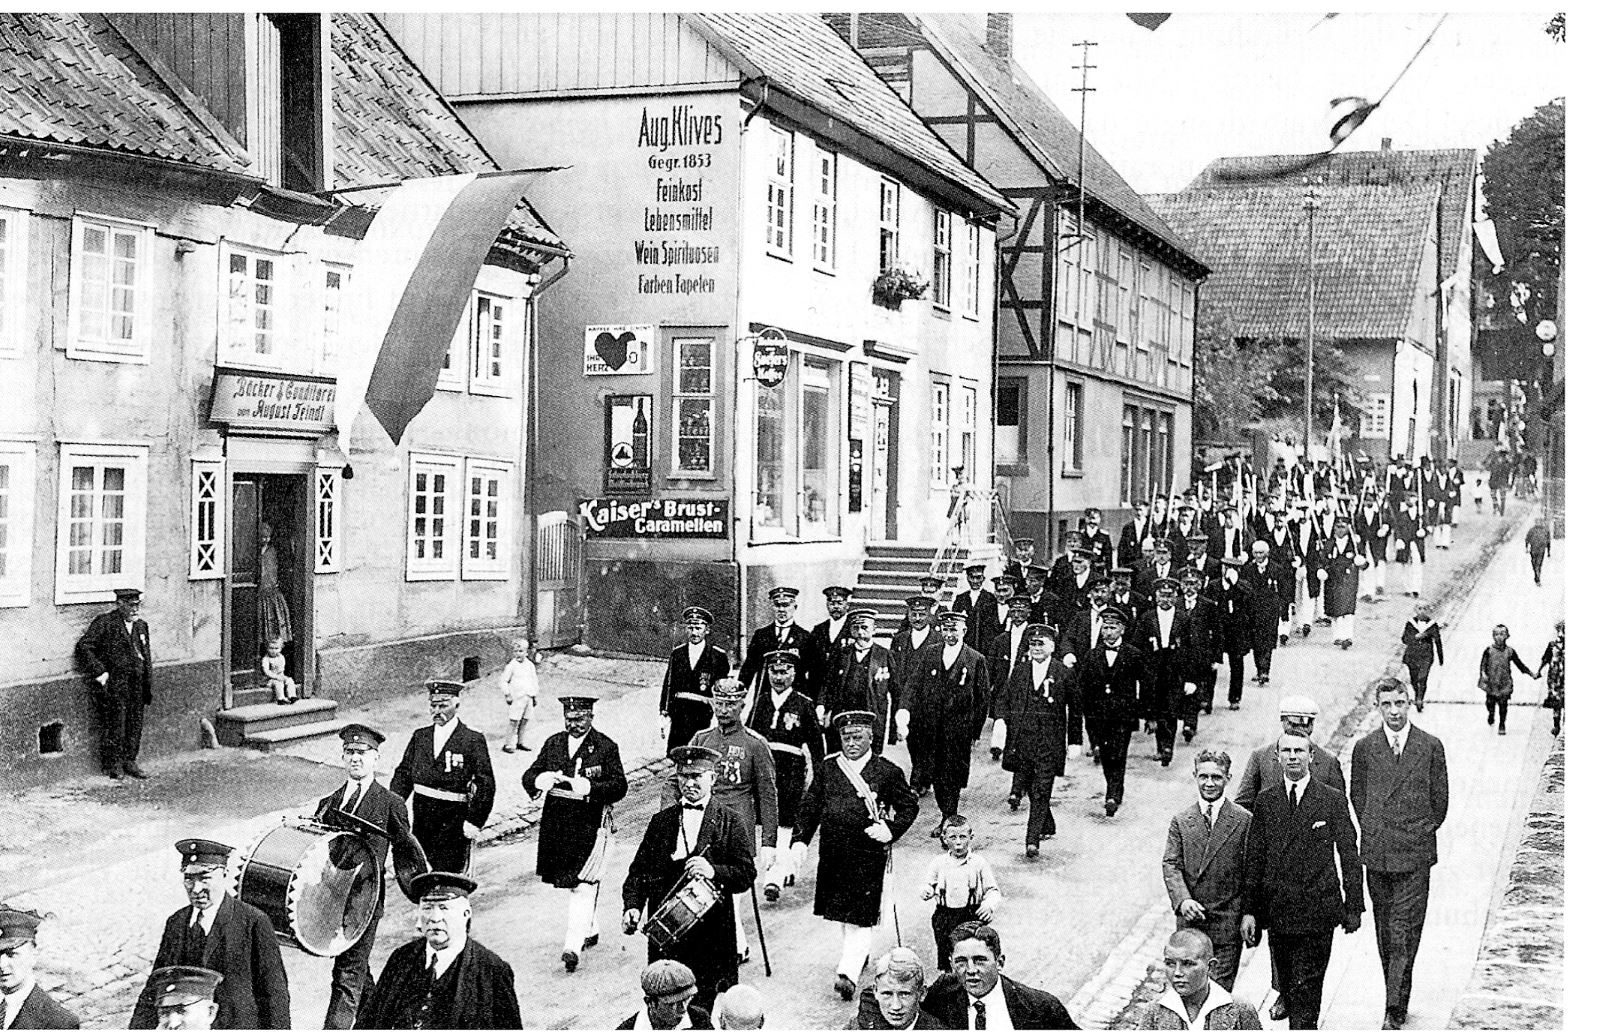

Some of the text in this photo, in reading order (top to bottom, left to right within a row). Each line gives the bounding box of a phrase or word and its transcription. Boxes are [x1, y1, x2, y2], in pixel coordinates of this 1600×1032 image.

[657, 177, 702, 202] Feinkost
[644, 206, 713, 231] Lebensmittel
[634, 239, 719, 267] Wein Spirituosen
[638, 273, 715, 296] Farben Tapeten
[586, 363, 609, 372] HERZ
[252, 399, 292, 420] August
[579, 499, 721, 532] Kaiser's Brust-
[634, 517, 723, 534] Caramellen
